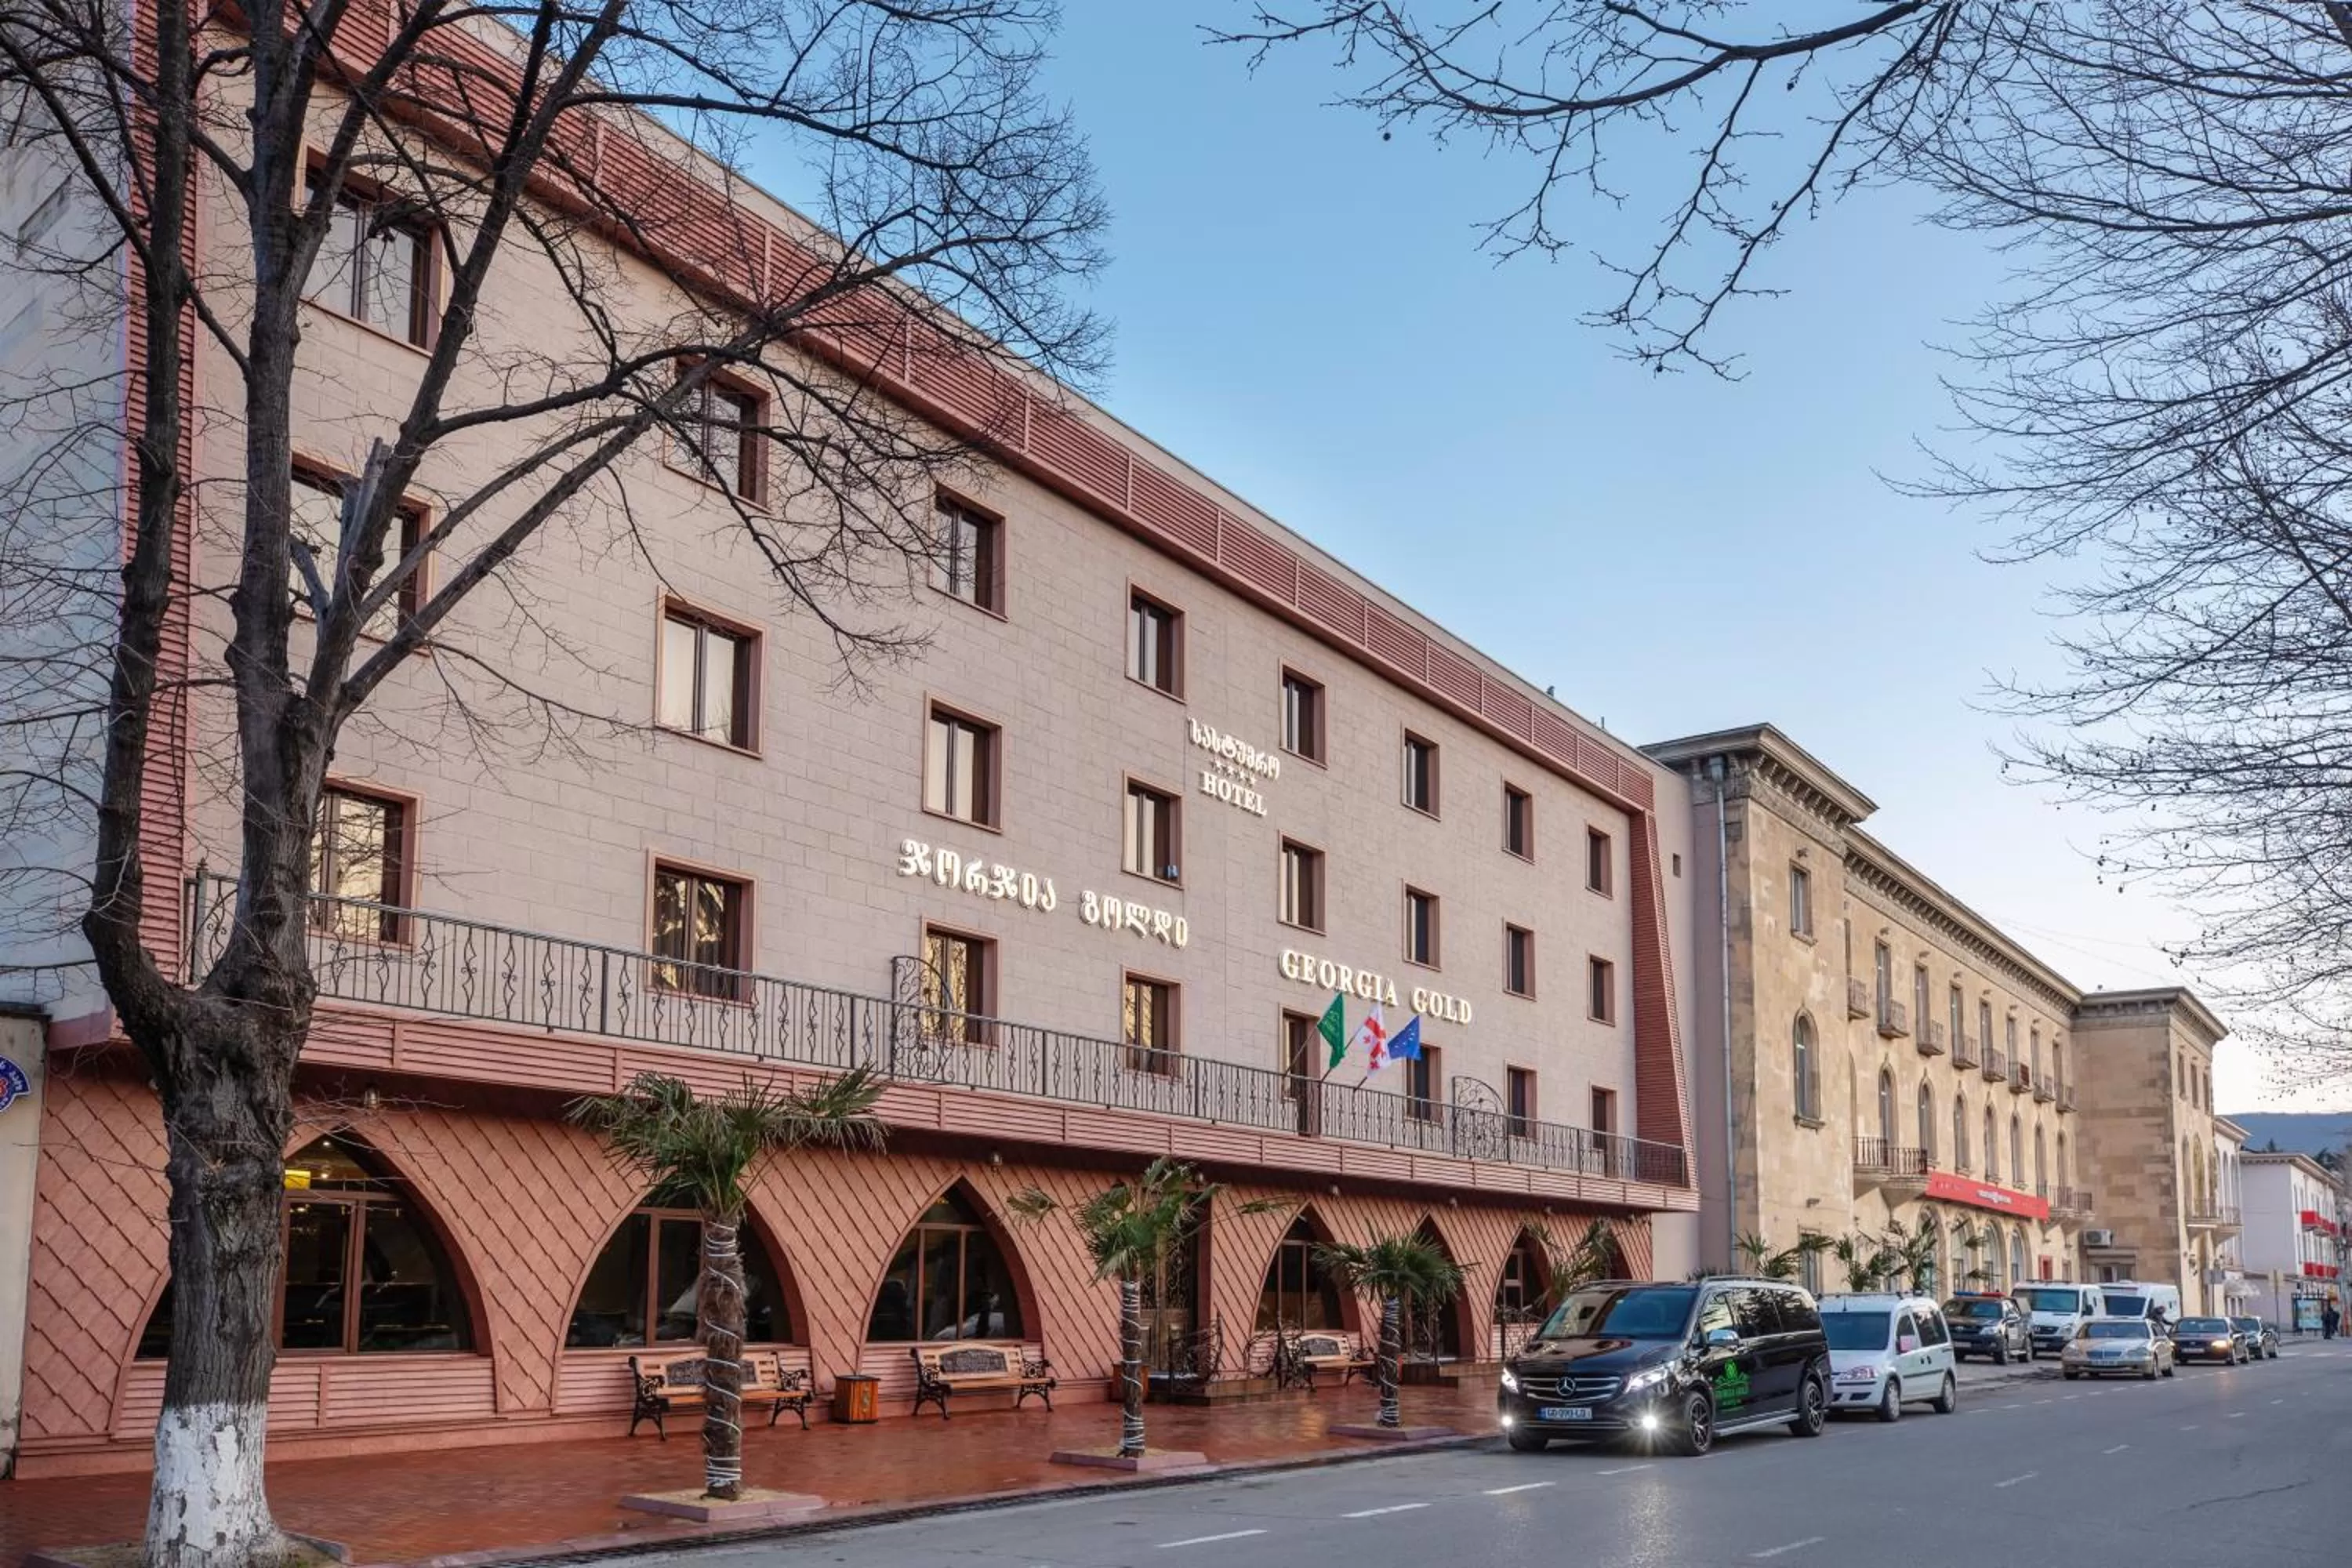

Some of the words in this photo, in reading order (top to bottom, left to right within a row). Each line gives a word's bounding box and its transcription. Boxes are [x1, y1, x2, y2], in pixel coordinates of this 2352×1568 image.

[1188, 717, 1280, 780] სასტუმრო
[1201, 771, 1268, 816] HOTEL
[898, 838, 1057, 913] ჯორჯია
[1080, 889, 1189, 949] გოლდი
[1279, 949, 1399, 1007] GEORGIA
[1412, 987, 1473, 1024] GOLD
